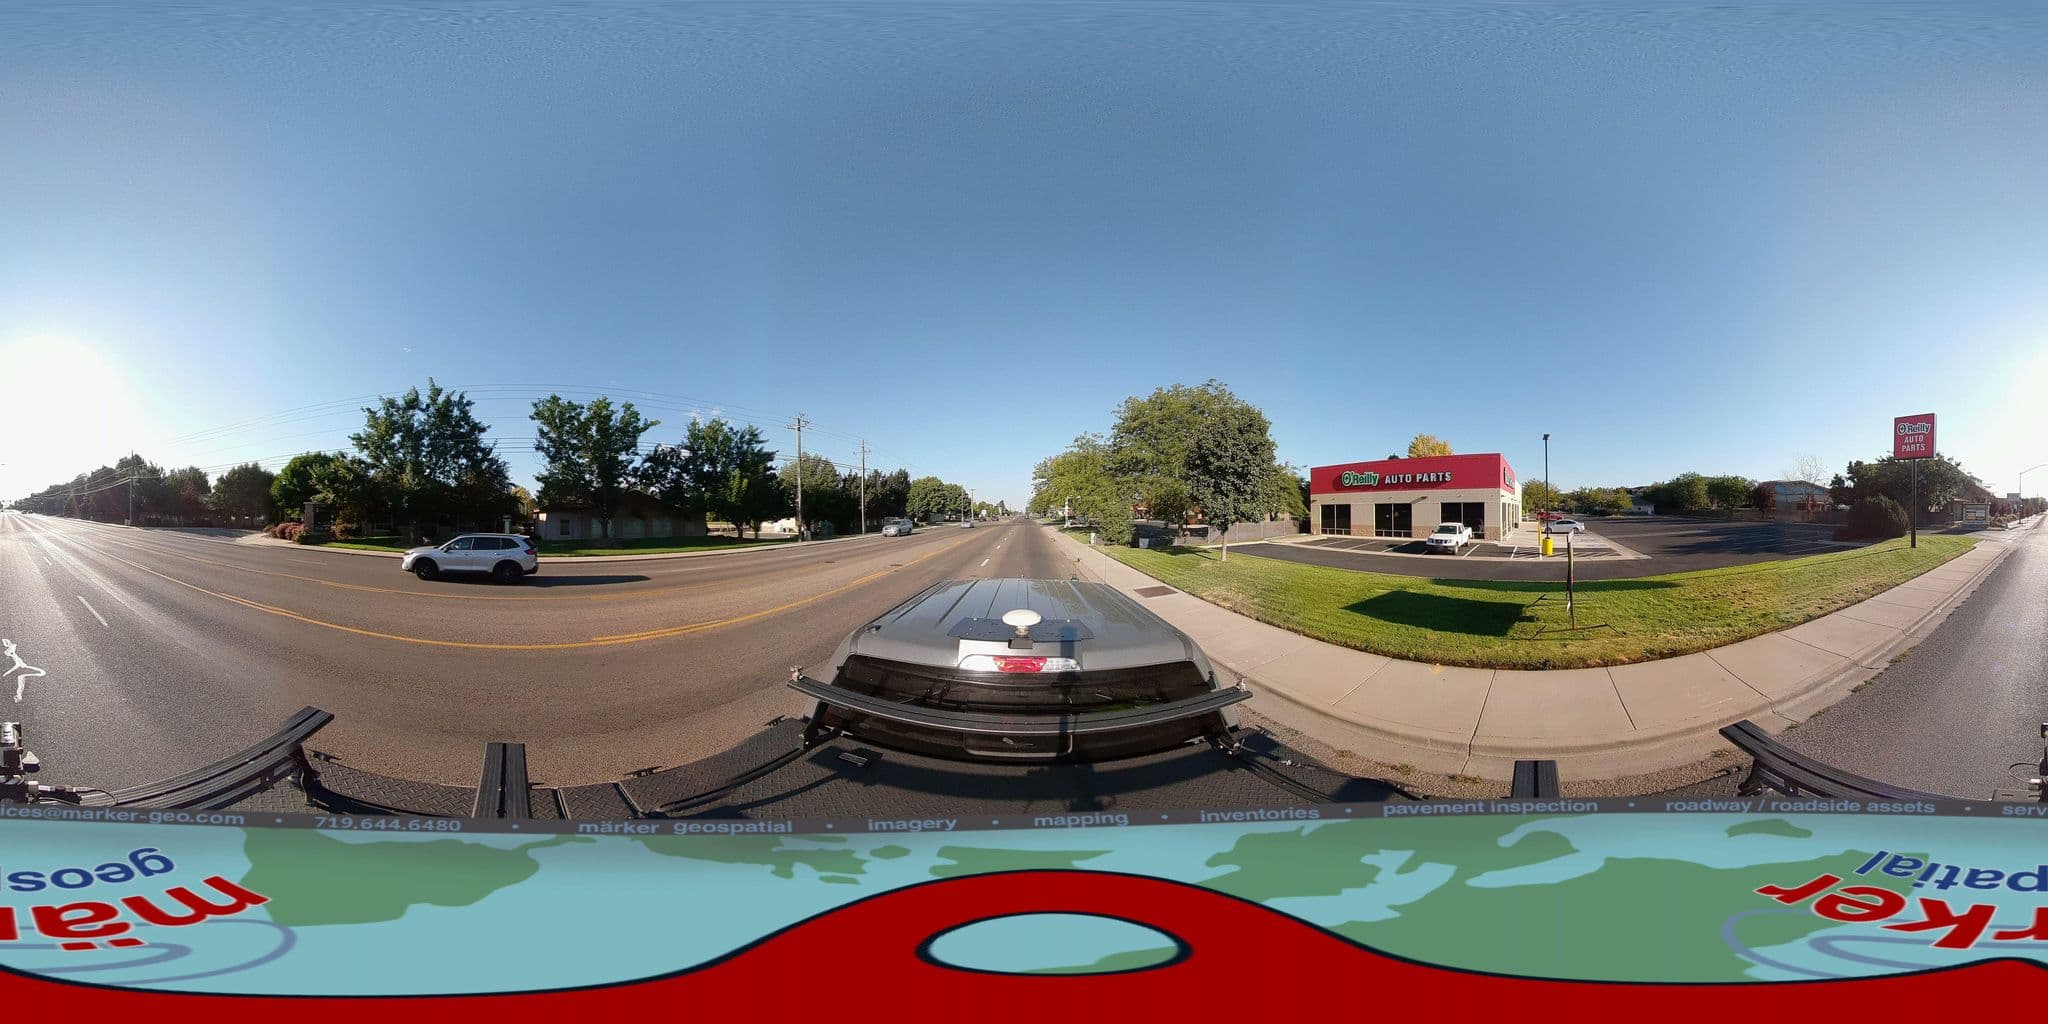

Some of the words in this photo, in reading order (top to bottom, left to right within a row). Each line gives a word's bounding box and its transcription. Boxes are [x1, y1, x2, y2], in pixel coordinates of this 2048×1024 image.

[1897, 423, 1930, 435] O'Reilly
[1904, 435, 1924, 443] AUTO
[1901, 443, 1926, 452] PARTS
[1341, 471, 1379, 486] O'Reilly
[1384, 474, 1412, 484] AUTO
[1416, 472, 1452, 483] PARTS
